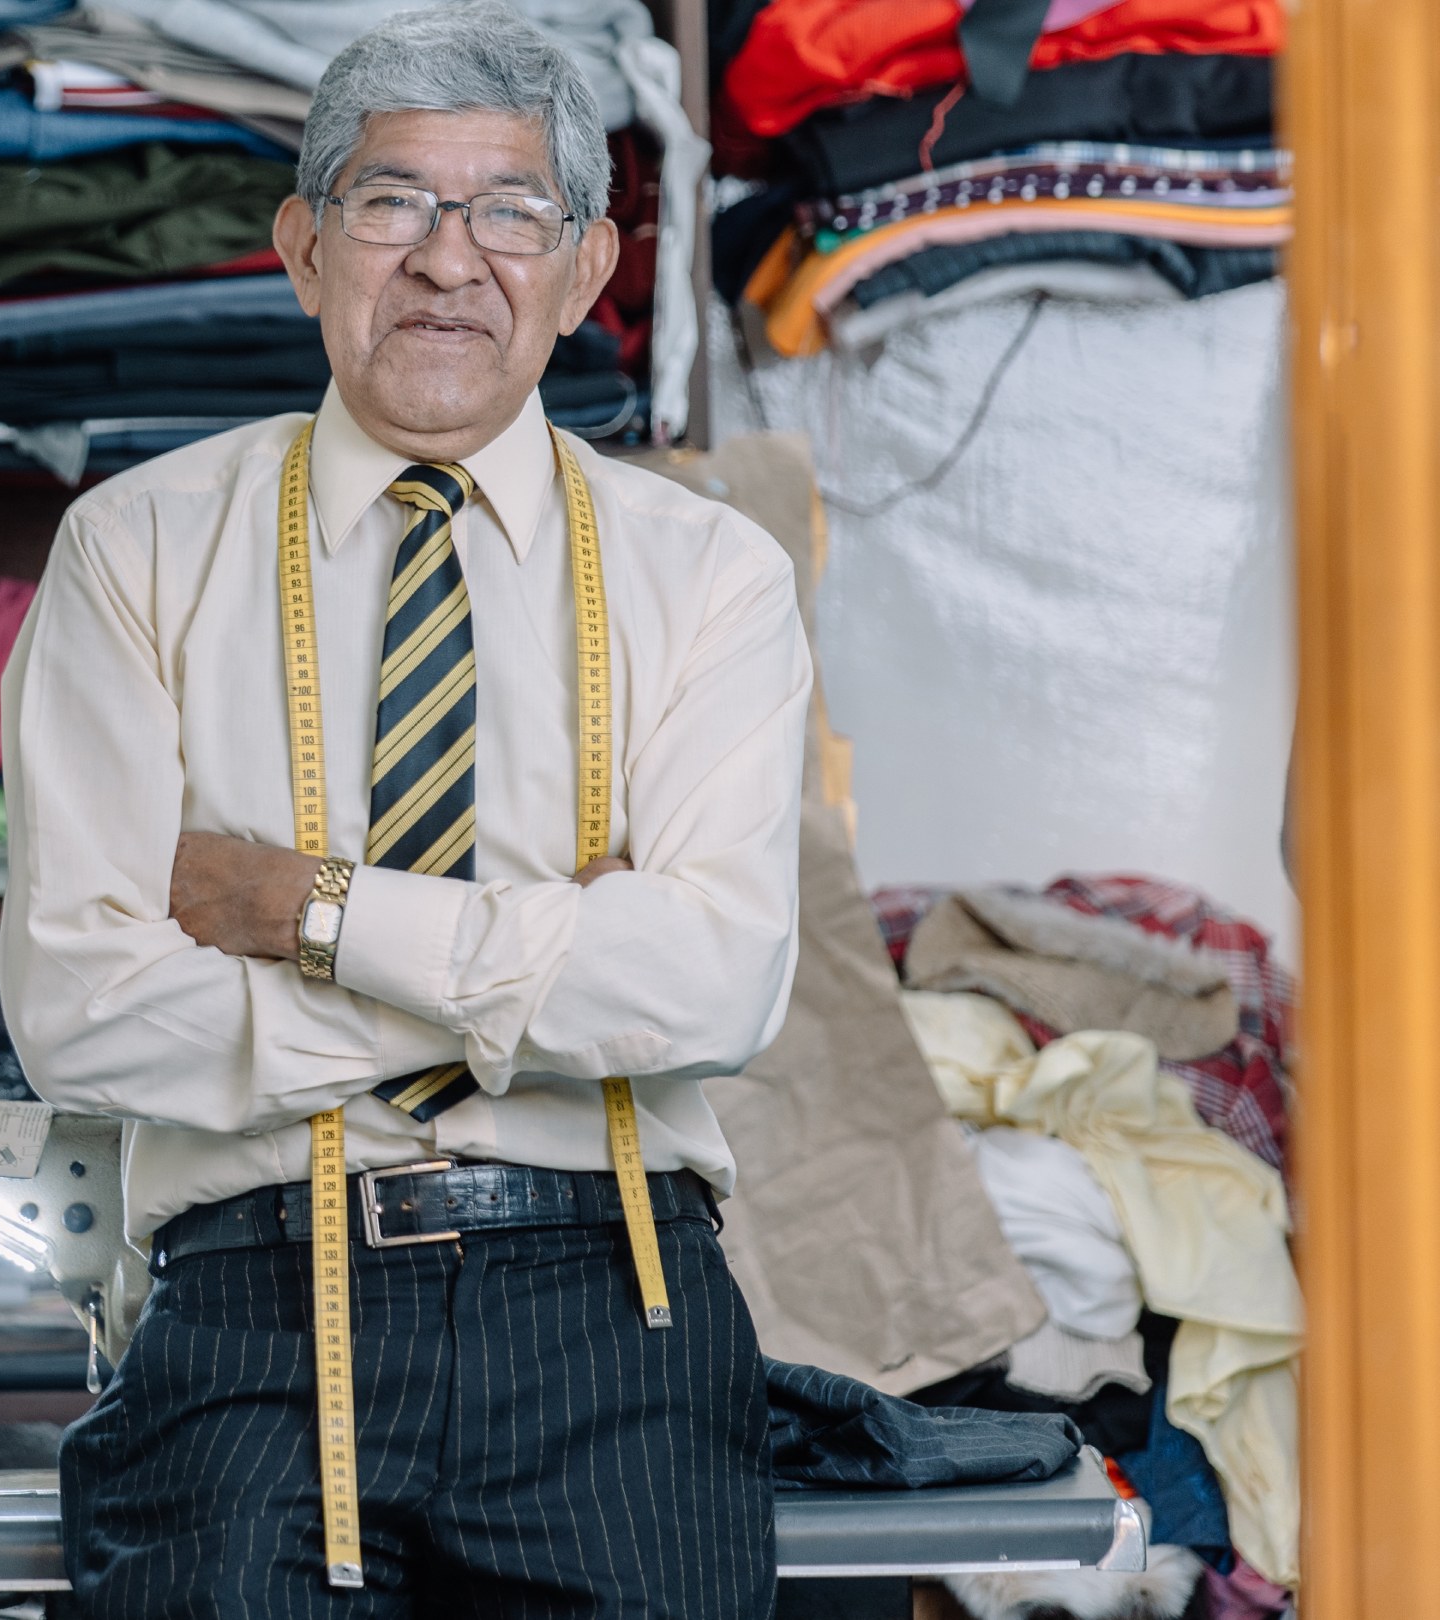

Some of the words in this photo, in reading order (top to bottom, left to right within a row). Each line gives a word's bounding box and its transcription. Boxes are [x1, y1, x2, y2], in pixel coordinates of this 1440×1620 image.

[291, 462, 298, 471] 84
[290, 474, 298, 482] 85
[289, 486, 298, 494] 86
[575, 489, 584, 498] 53
[289, 497, 297, 506] 87
[577, 499, 586, 508] 52
[289, 510, 298, 519] 88
[580, 511, 588, 520] 51
[289, 522, 298, 531] 89
[581, 522, 589, 532] 50
[289, 536, 298, 545] 90
[582, 535, 591, 544] 49
[290, 550, 298, 559] 91
[583, 548, 591, 557] 48
[291, 564, 300, 572] 92
[584, 562, 592, 570] 47
[584, 574, 594, 582] 46
[292, 579, 302, 588] 93
[586, 585, 595, 593] 45
[293, 594, 303, 602] 94
[294, 609, 304, 618] 95
[588, 610, 598, 619] 43
[295, 624, 305, 632] 96
[589, 624, 598, 632] 42
[296, 639, 306, 648] 97
[590, 639, 599, 647] 41
[297, 654, 307, 663] 98
[590, 653, 600, 662] 40
[299, 670, 309, 678] 99
[590, 669, 600, 677] 39
[299, 686, 312, 695] 100
[591, 684, 600, 693] 38
[299, 702, 312, 711] 101
[592, 700, 601, 709] 37
[300, 718, 314, 728] 102
[592, 717, 601, 726] 36
[301, 735, 315, 745] 103
[592, 734, 601, 744] 35
[302, 752, 316, 761] 104
[592, 752, 601, 762] 34
[303, 769, 316, 778] 105
[592, 770, 601, 780] 33
[304, 786, 317, 796] 106
[592, 787, 601, 797] 32
[304, 804, 318, 814] 107
[592, 804, 600, 814] 31
[305, 822, 318, 831] 108
[590, 821, 600, 831] 30
[305, 840, 319, 849] 109
[589, 838, 599, 847] 29
[616, 1100, 625, 1111] 13
[322, 1113, 335, 1122] 125
[619, 1118, 627, 1128] 12
[322, 1130, 335, 1139] 126
[623, 1137, 630, 1146] 11
[322, 1147, 335, 1157] 127
[323, 1164, 336, 1174] 128
[323, 1182, 336, 1191] 129
[323, 1199, 336, 1208] 130
[324, 1216, 336, 1225] 131
[324, 1233, 338, 1242] 132
[325, 1250, 338, 1259] 133
[325, 1267, 338, 1276] 134
[326, 1284, 338, 1294] 135
[326, 1302, 339, 1311] 136
[327, 1318, 339, 1328] 137
[327, 1335, 340, 1344] 138
[328, 1351, 341, 1361] 139
[329, 1367, 342, 1377] 140
[330, 1384, 342, 1393] 141
[331, 1400, 343, 1410] 142
[331, 1417, 344, 1427] 143
[332, 1434, 344, 1444] 144
[333, 1451, 345, 1460] 145
[334, 1485, 346, 1494] 147
